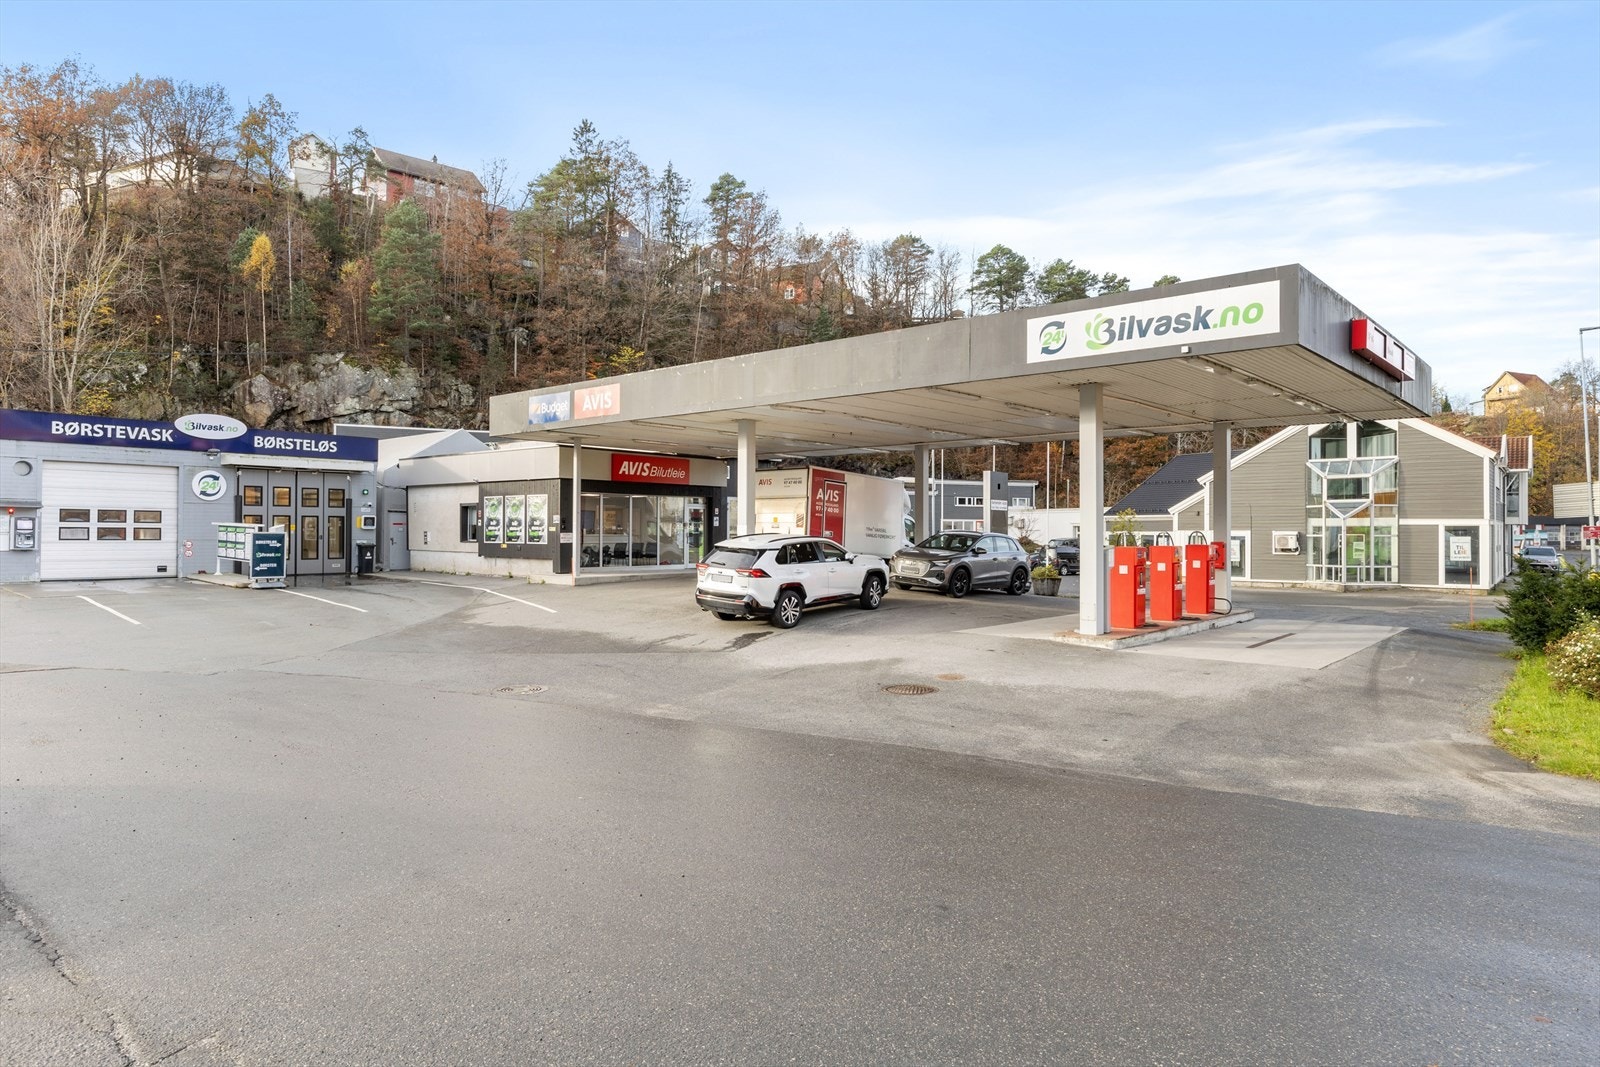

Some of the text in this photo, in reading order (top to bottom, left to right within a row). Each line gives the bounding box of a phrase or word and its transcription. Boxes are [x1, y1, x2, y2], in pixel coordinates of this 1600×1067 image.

[1085, 302, 1264, 350] Bilvask.no
[541, 400, 569, 415] Budget
[582, 391, 612, 411] AVIS
[51, 420, 174, 442] BØRSTEVASK
[184, 419, 239, 433] Bilvask.no
[253, 435, 338, 453] BØRSTELØS
[619, 460, 686, 479] AVIS Bilutleie
[758, 478, 773, 486] AVIS
[816, 488, 839, 502] AVIS
